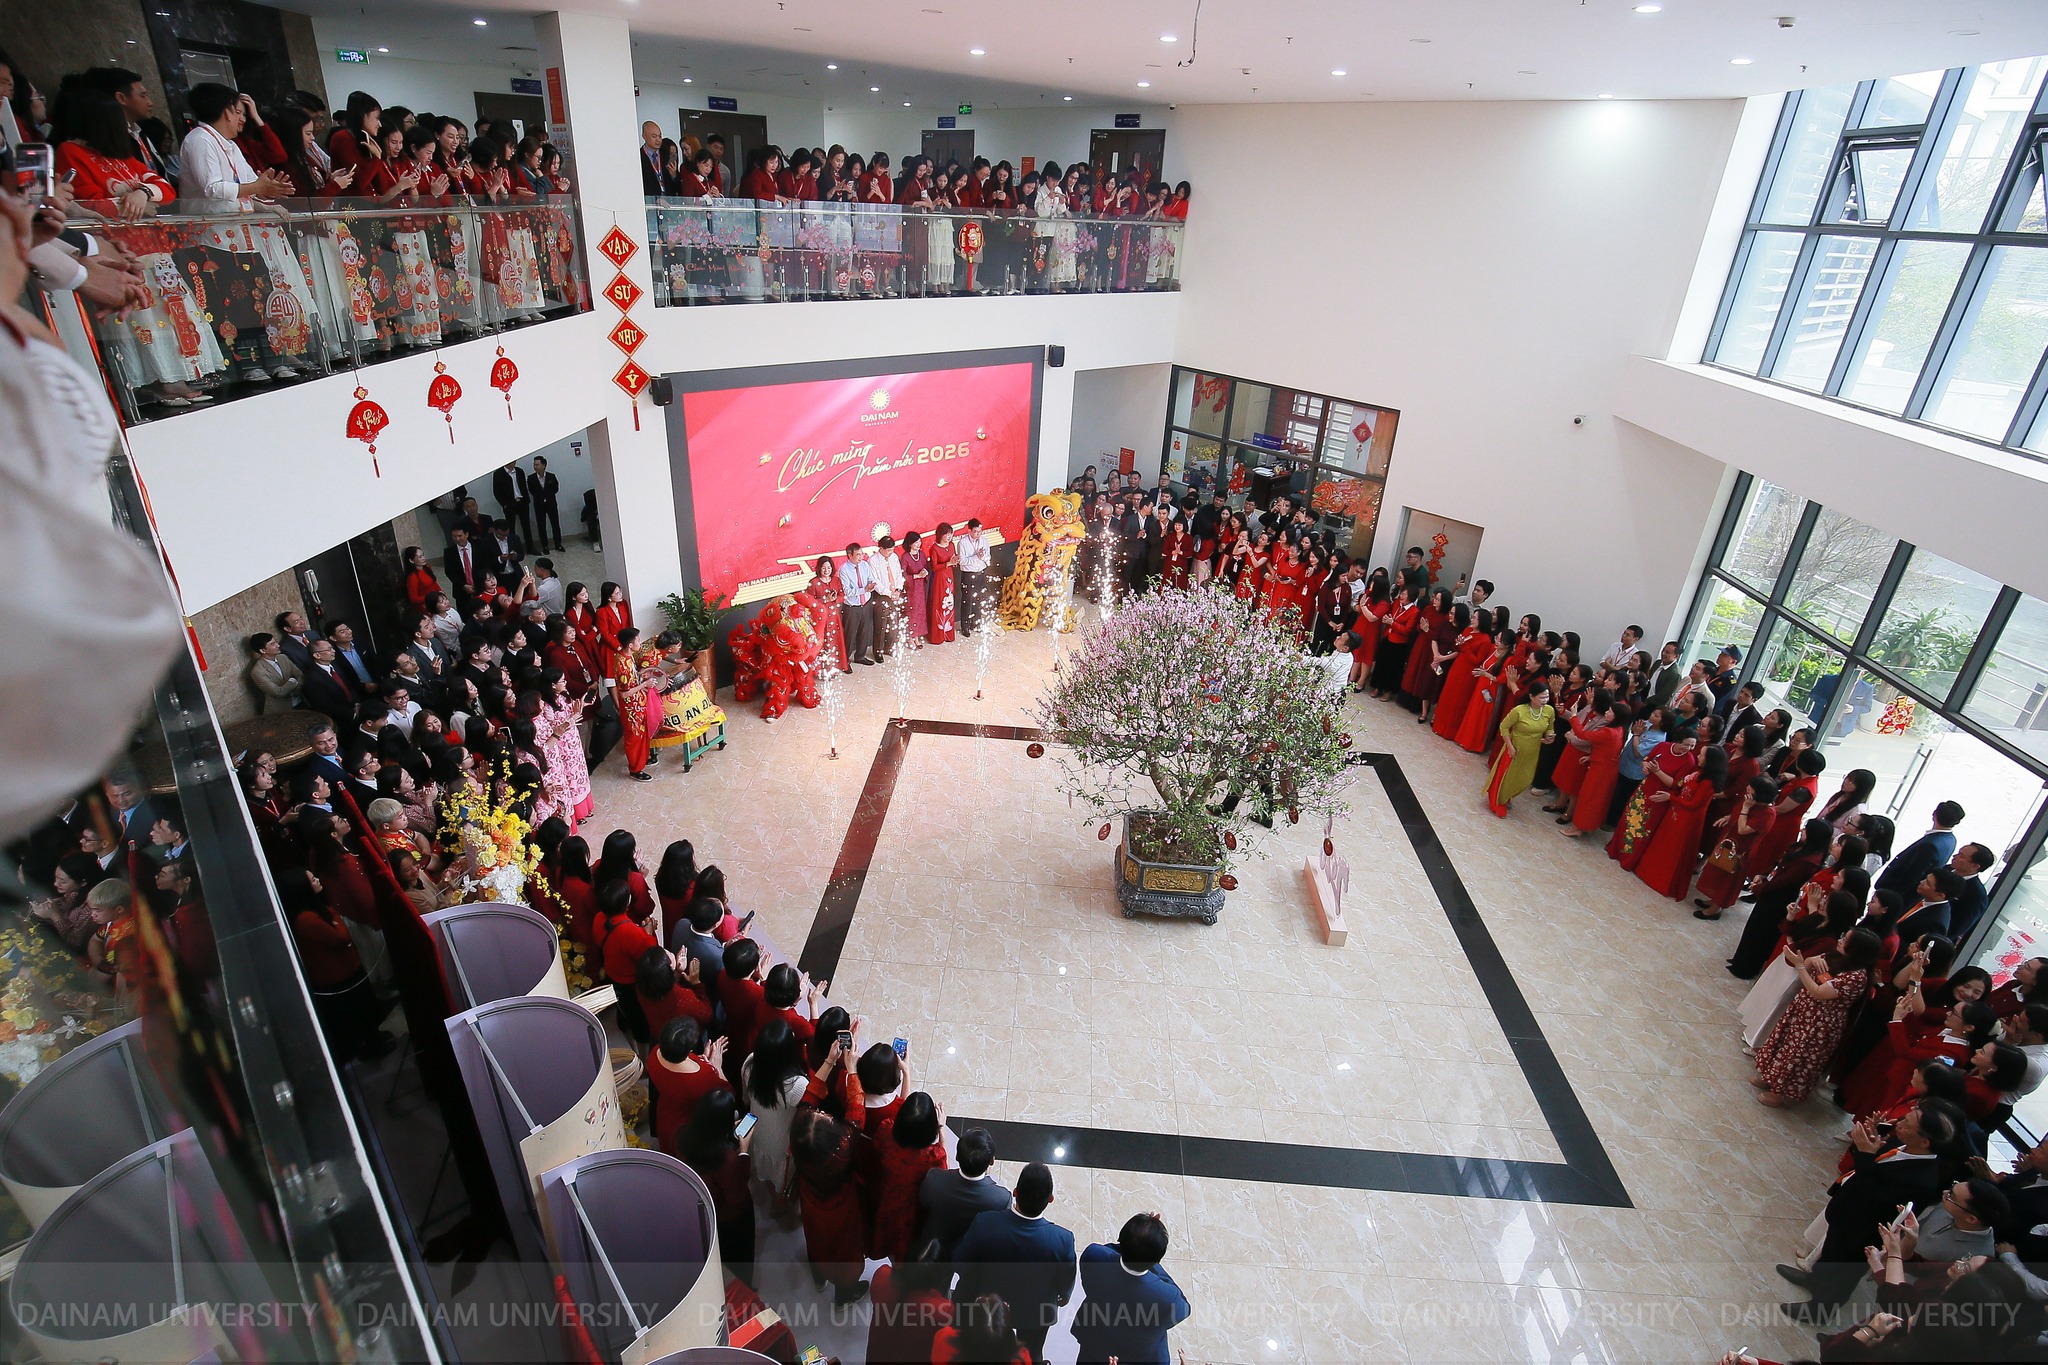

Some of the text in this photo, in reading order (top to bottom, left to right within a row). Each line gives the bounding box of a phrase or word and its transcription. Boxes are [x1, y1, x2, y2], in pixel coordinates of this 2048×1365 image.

[606, 237, 629, 260] VẠN
[614, 284, 632, 303] SỰ
[777, 448, 827, 492] Chúc
[917, 441, 970, 464] 2026
[685, 705, 700, 721] AN
